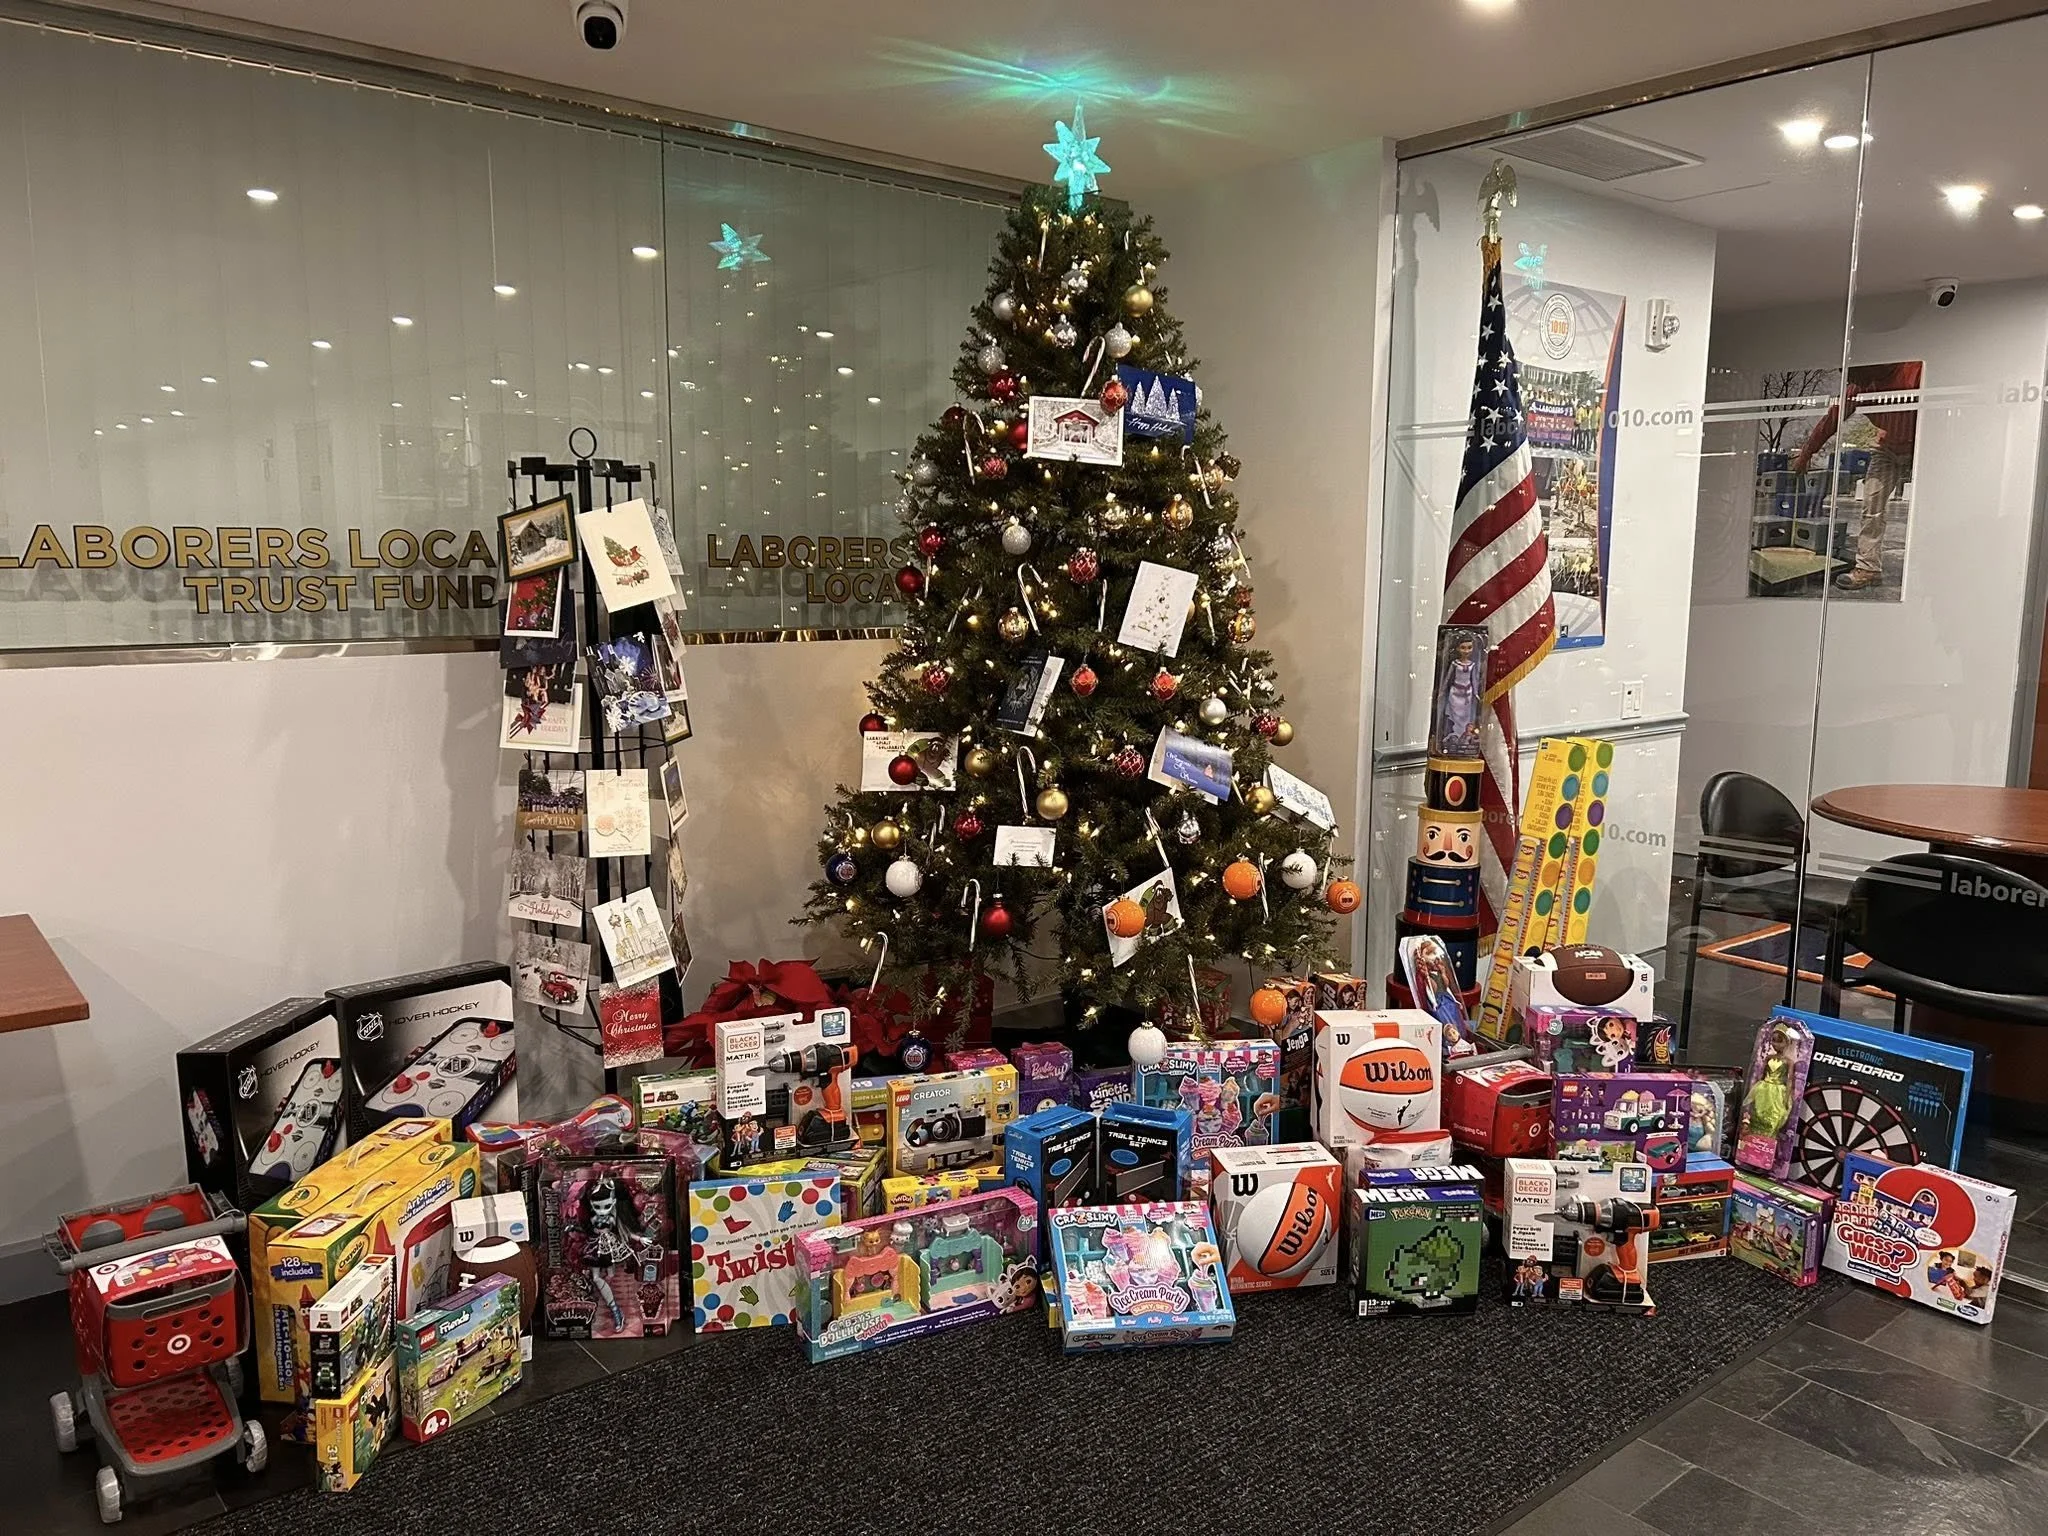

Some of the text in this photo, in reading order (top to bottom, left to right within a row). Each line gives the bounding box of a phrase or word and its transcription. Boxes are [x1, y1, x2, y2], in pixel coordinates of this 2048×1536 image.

[707, 533, 909, 570] LABORERS
[184, 575, 497, 614] TRUST FUND
[1950, 871, 2048, 908] laborer
[1575, 950, 1604, 958] NCAA
[388, 1011, 431, 1027] HOVER
[432, 1001, 480, 1017] HOCKEY
[612, 1008, 649, 1024] Merry
[605, 1020, 657, 1037] Christmas
[729, 1041, 758, 1050] DECKER
[1286, 1032, 1309, 1052] Jenga
[260, 1041, 321, 1079] HOVER HOCKEY
[726, 1052, 760, 1062] MATRIX
[1837, 1047, 1884, 1066] ELECTRONIC
[1363, 1061, 1433, 1083] Wilson
[1812, 1051, 1905, 1083] DARTBOARD
[895, 1094, 911, 1103] LEGO
[913, 1088, 952, 1101] CREATOR
[1089, 1082, 1129, 1101] Kinetic
[1563, 1084, 1578, 1093] LEGO
[1108, 1131, 1168, 1147] TABLE TENNIS
[1476, 1128, 1487, 1137] Cart
[1048, 1131, 1091, 1154] TABLE TENNIS
[1063, 1144, 1077, 1154] SET
[1128, 1141, 1146, 1149] SET
[1010, 1155, 1035, 1168] TENNIS
[1012, 1149, 1033, 1161] TABLE
[1409, 1164, 1485, 1181] MEGA
[406, 1178, 448, 1212] Art-To-Go
[1354, 1188, 1431, 1204] MEGA
[1518, 1185, 1549, 1193] DECKER
[1513, 1196, 1550, 1205] MATRIX
[1370, 1209, 1386, 1220] MEGA
[743, 1233, 757, 1241] game
[281, 1256, 300, 1268] 128
[338, 1239, 365, 1269] Crayola
[280, 1265, 314, 1276] included
[1320, 1269, 1331, 1277] SIZE
[1256, 1280, 1272, 1289] SERIES
[1114, 1288, 1186, 1310] Ice Cream Party
[439, 1310, 471, 1335] Friends
[420, 1330, 436, 1346] LEGO
[819, 1315, 881, 1347] DOLLHOUSE
